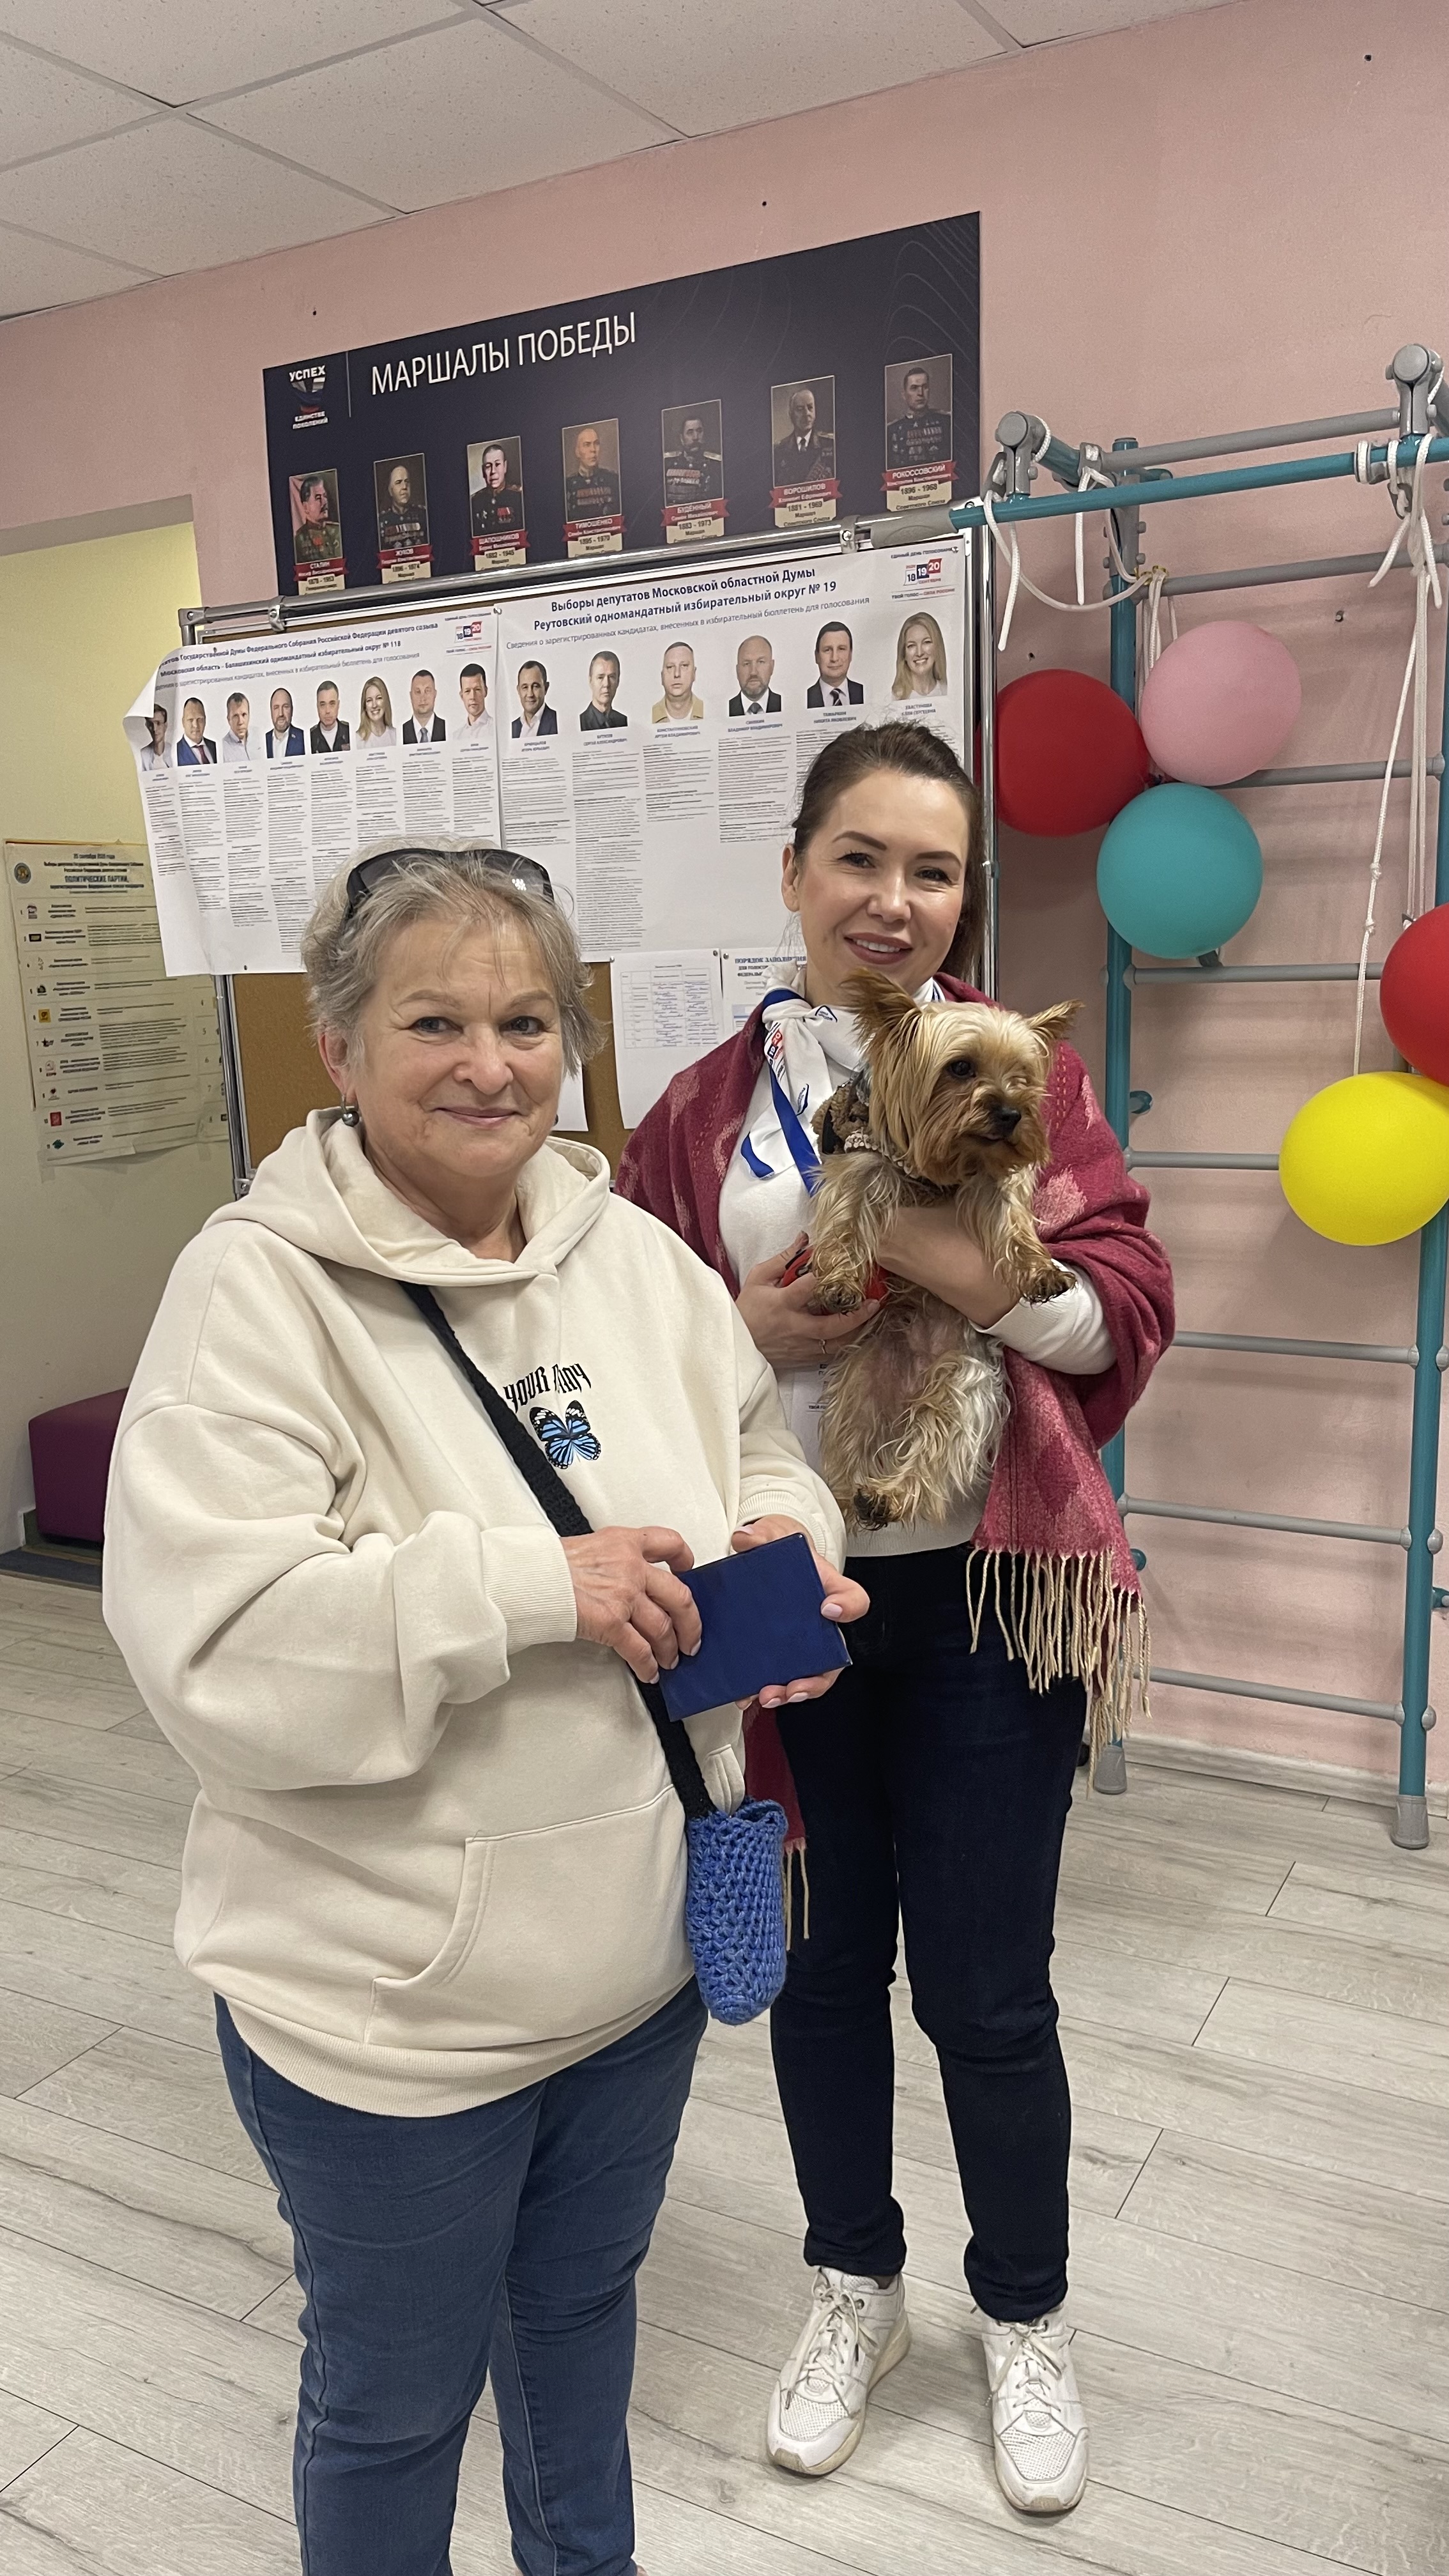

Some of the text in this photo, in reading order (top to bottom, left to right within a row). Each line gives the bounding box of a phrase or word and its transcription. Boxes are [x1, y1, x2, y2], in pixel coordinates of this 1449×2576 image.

[371, 312, 636, 395] МАРШАЛЫ ПОБЕДЫ
[289, 365, 326, 382] УСПЕХ
[893, 463, 946, 479] РОКОССОВСКИЙ
[783, 483, 826, 495] ВОРОШИЛОВ
[917, 567, 926, 576] 19
[928, 562, 940, 571] 20
[907, 574, 916, 582] 18
[551, 569, 815, 612] Выборы депутатов Московской областной Думы
[534, 581, 836, 631] Реутовский одномандатный избирательный округ № 19
[471, 624, 480, 632] 20
[507, 640, 538, 649] Сведения
[545, 630, 616, 645] зарегистрированных
[617, 625, 659, 636] кандидатах,
[661, 620, 699, 630] внесенных
[706, 611, 762, 624] избирательный
[764, 607, 804, 617] бюллетень
[805, 604, 819, 613] для
[820, 597, 870, 610] голосования
[247, 643, 288, 653] Федерального
[288, 638, 316, 648] Собрания
[352, 630, 387, 640] Федерации
[387, 625, 415, 635] девятого
[416, 623, 438, 631] созыва
[318, 645, 364, 657] избирательный
[365, 643, 381, 652] округ
[772, 1032, 781, 1045] 20
[503, 1366, 551, 1414] YOUR
